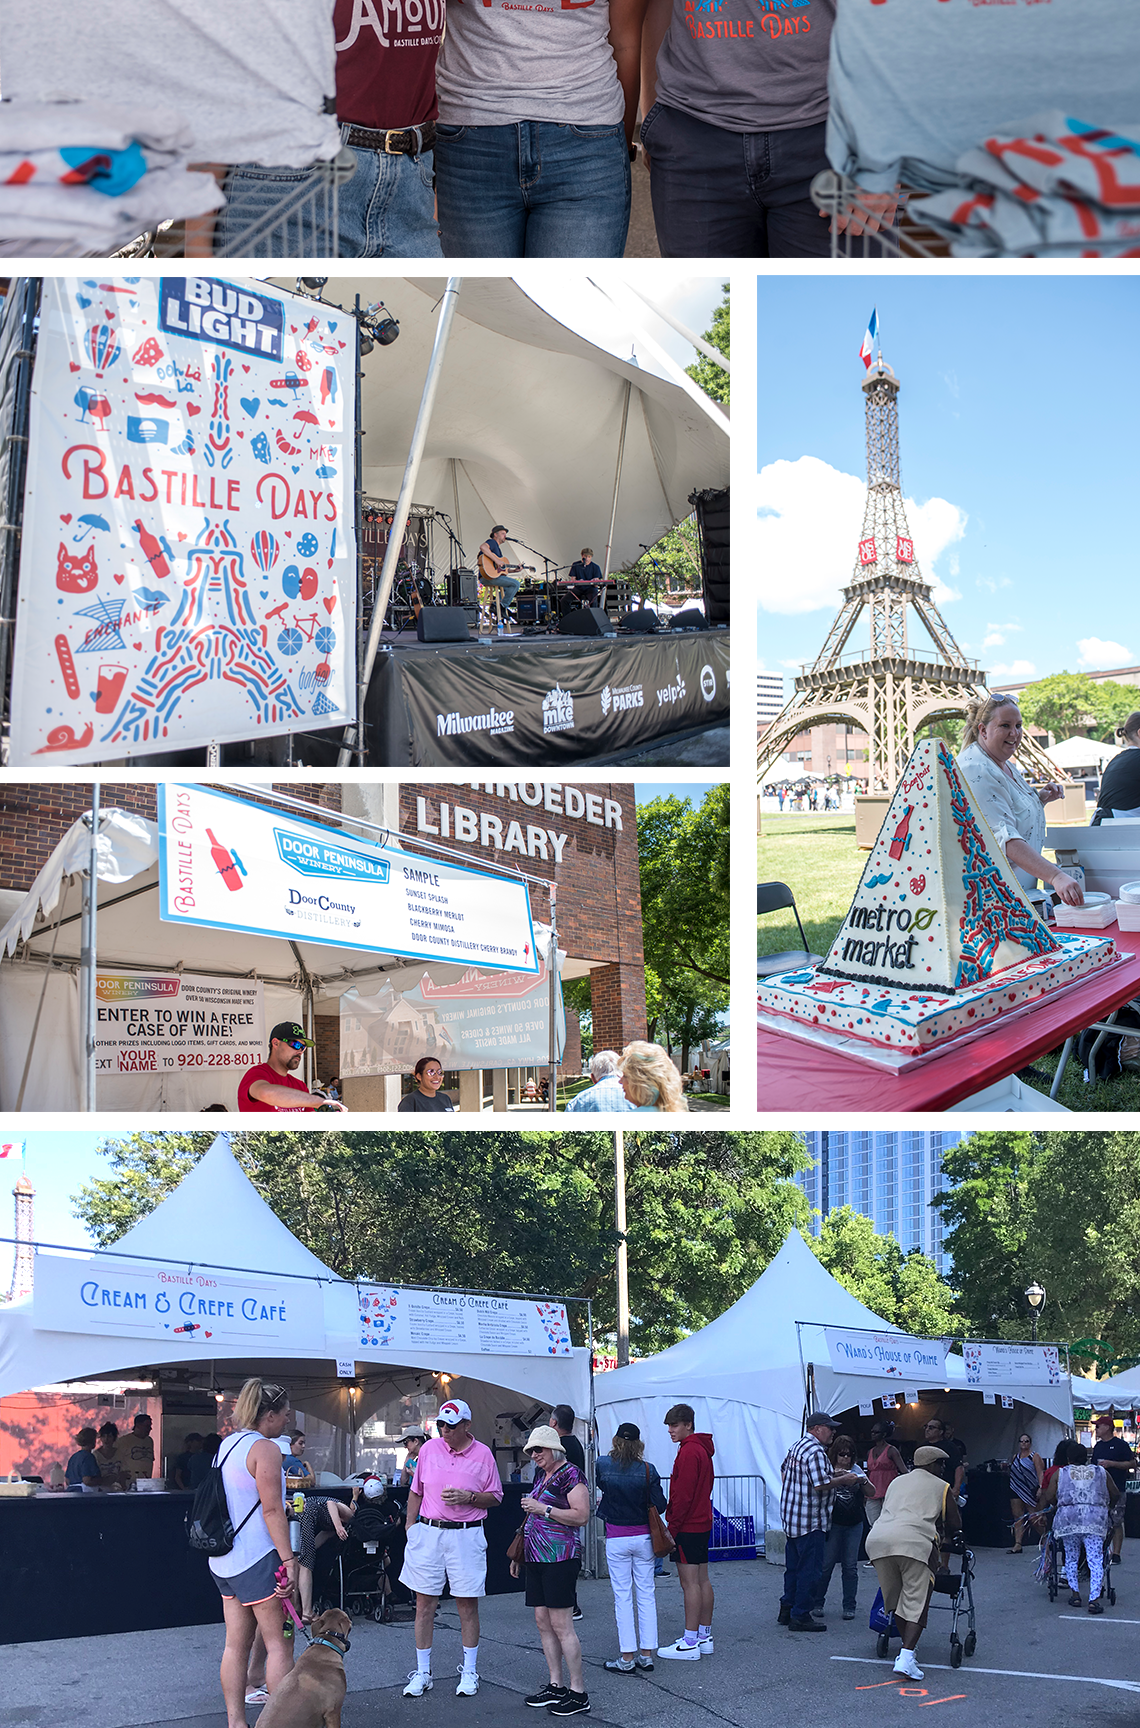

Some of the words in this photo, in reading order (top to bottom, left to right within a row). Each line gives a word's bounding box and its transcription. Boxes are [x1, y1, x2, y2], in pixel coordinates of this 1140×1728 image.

[501, 2, 533, 11] BASTILLE
[534, 3, 554, 13] DAYS
[685, 14, 755, 40] BASTILLE
[761, 13, 811, 39] DAYS
[185, 277, 264, 322] BUD
[166, 297, 277, 354] LIGHT
[310, 445, 335, 462] MKE
[61, 444, 241, 512] BASTILLE
[256, 472, 338, 522] DAYS
[613, 691, 644, 712] PARKS
[657, 684, 678, 707] yelp
[437, 707, 515, 736] Milwaukee
[543, 705, 574, 725] mke
[490, 725, 514, 735] MAGAZINE
[543, 721, 575, 734] DOWNTOWN
[172, 792, 193, 834] DAYS
[417, 796, 568, 863] LIBRARY
[282, 837, 321, 860] DOOR
[324, 849, 384, 877] PENINSULA
[297, 856, 343, 874] WINERY
[174, 840, 196, 913] BASTILLE
[403, 867, 440, 887] SAMPLE
[405, 888, 427, 900] SUNSET
[428, 893, 449, 904] SPLASH
[297, 910, 351, 927] DISTILLERY
[407, 903, 443, 917] BLACKBERRY
[443, 910, 464, 921] MERLOT
[849, 903, 912, 932] metro
[409, 918, 432, 929] CHERRY
[433, 922, 455, 933] MIMOSA
[411, 932, 428, 943] DOOR
[428, 935, 450, 946] COUNTY
[450, 938, 480, 951] DISTILLERY
[480, 943, 499, 954] CHERRY
[500, 947, 518, 956] BRANDY
[842, 934, 919, 969] market
[124, 981, 174, 992] PENINSULA
[196, 986, 221, 994] COUNTY'S
[222, 988, 242, 996] ORIGINAL
[97, 1008, 149, 1022] ENTER
[154, 1009, 172, 1022] TO
[177, 1010, 205, 1023] WIN
[210, 1012, 219, 1023] A
[221, 1013, 254, 1025] FREE
[127, 1023, 165, 1037] CASE
[169, 1024, 188, 1037] OF
[192, 1024, 233, 1037] WINE!
[120, 1050, 156, 1061] YOUR
[120, 1060, 157, 1071] NAME
[162, 1057, 174, 1067] TO
[177, 1053, 262, 1066] 920-228-8011
[157, 1272, 194, 1285] BASTILLE
[196, 1276, 218, 1288] DAYS
[80, 1281, 147, 1310] CREAM
[155, 1291, 171, 1314] &
[179, 1291, 234, 1318] CREPE
[242, 1298, 287, 1321] CAFÉ
[432, 1294, 457, 1306] CREAM
[468, 1297, 489, 1308] CREPE
[836, 1342, 873, 1359] WARD'S
[874, 1346, 902, 1362] HOUSE
[904, 1354, 911, 1363] OF
[914, 1351, 938, 1366] PRIME
